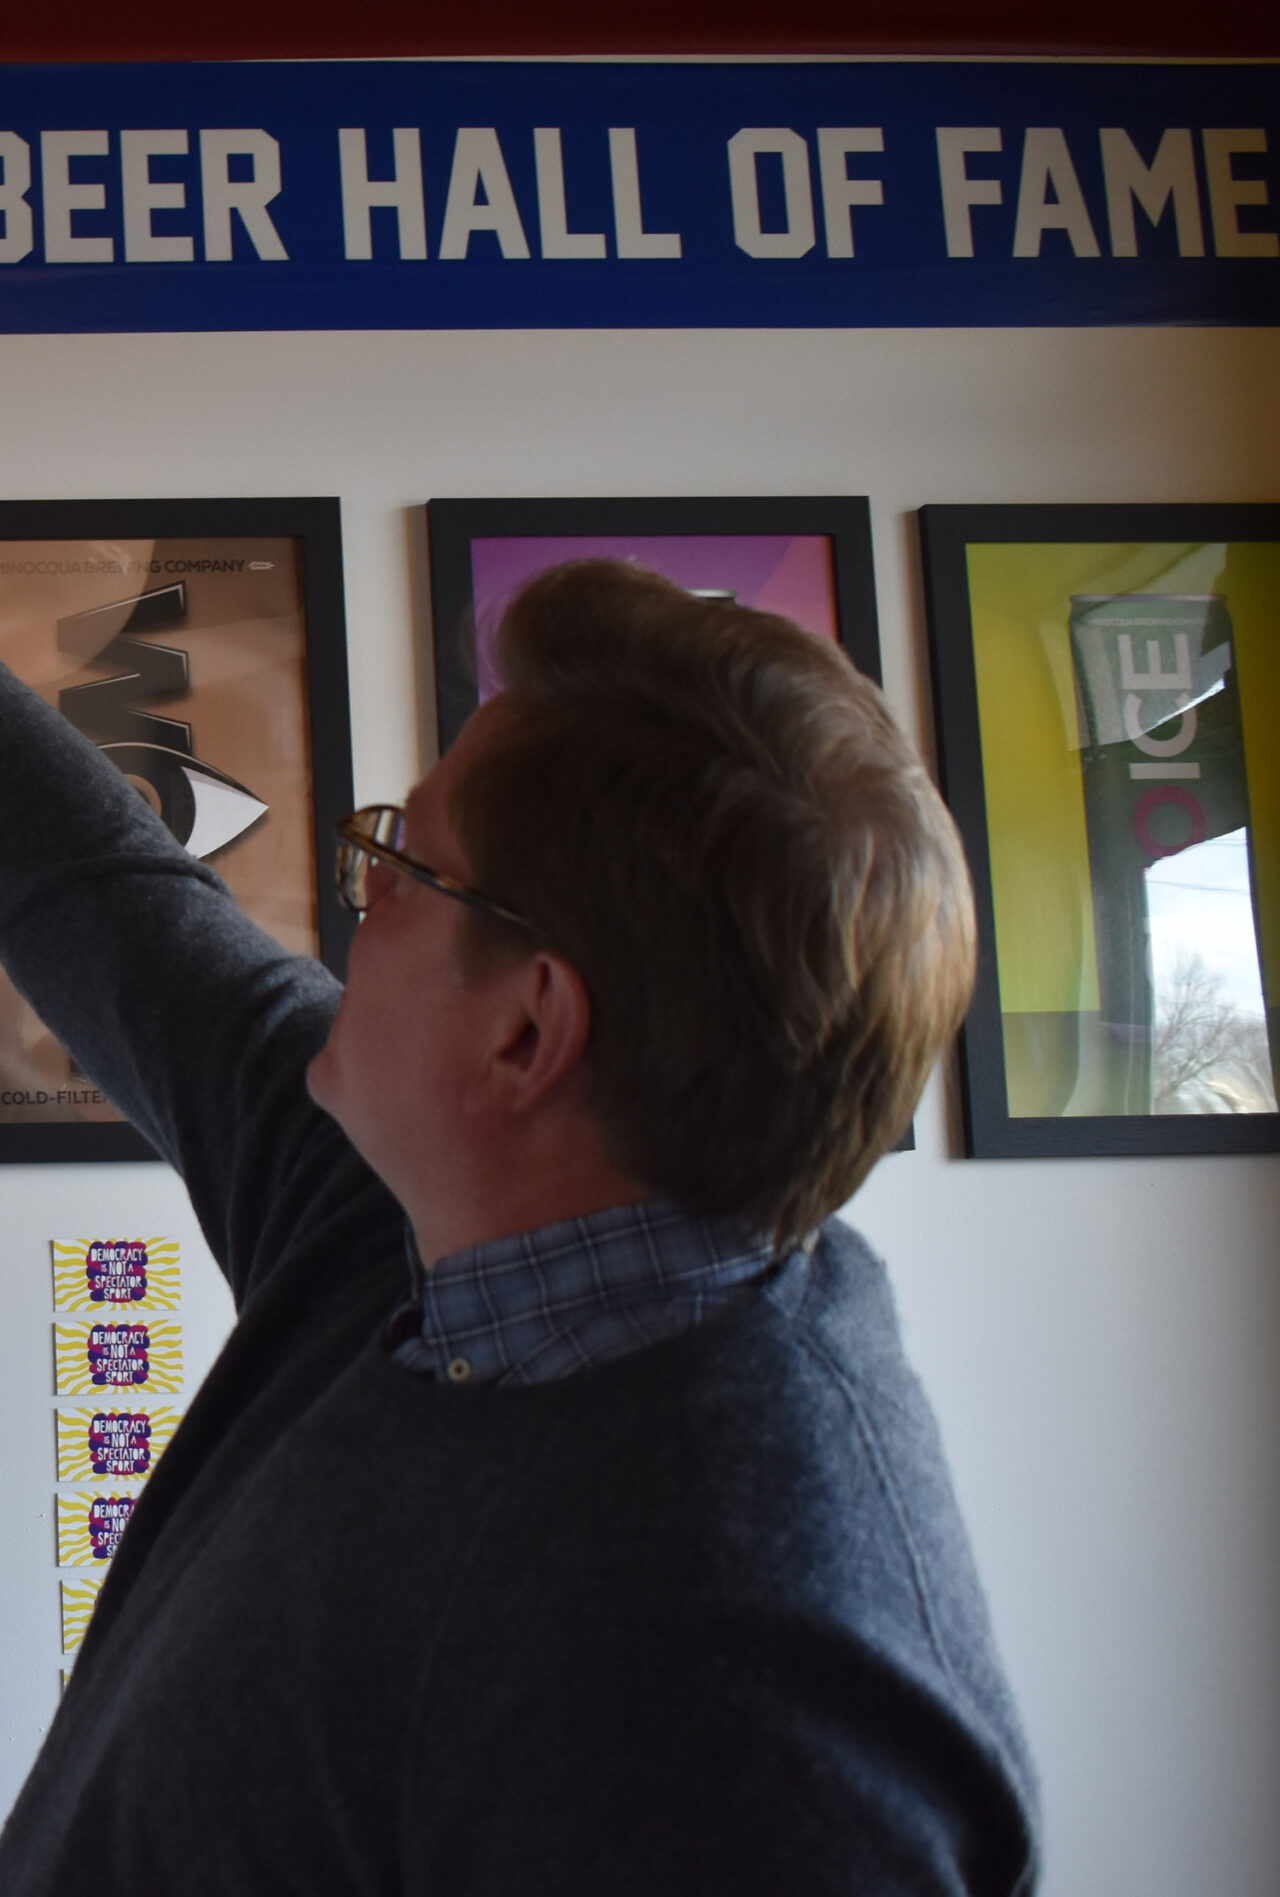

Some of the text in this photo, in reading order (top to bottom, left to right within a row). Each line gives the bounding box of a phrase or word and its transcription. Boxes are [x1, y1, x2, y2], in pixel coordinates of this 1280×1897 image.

[337, 127, 682, 260] HALL
[727, 127, 885, 258] OF
[935, 127, 1280, 258] FAME
[165, 560, 246, 573] COMPANY
[1, 1090, 107, 1106] COLD-FILTE
[91, 1248, 144, 1262] DEMOCRACY
[109, 1262, 127, 1275] NOT
[128, 1264, 134, 1272] A
[95, 1276, 142, 1288] SPECTATOR
[104, 1288, 132, 1299] SPORT
[93, 1331, 146, 1345] DEMOCRACY
[111, 1345, 128, 1358] NOT
[130, 1347, 136, 1355] A
[97, 1359, 144, 1371] SPECTATOR
[106, 1371, 134, 1382] SPORT
[93, 1420, 146, 1433] DEMOCRACY
[112, 1433, 130, 1447] NOT
[131, 1435, 137, 1444] A
[97, 1447, 145, 1460] SPECTATOR
[106, 1460, 134, 1472] SPORT
[112, 1518, 128, 1532] NO
[98, 1532, 122, 1545] SPEC
